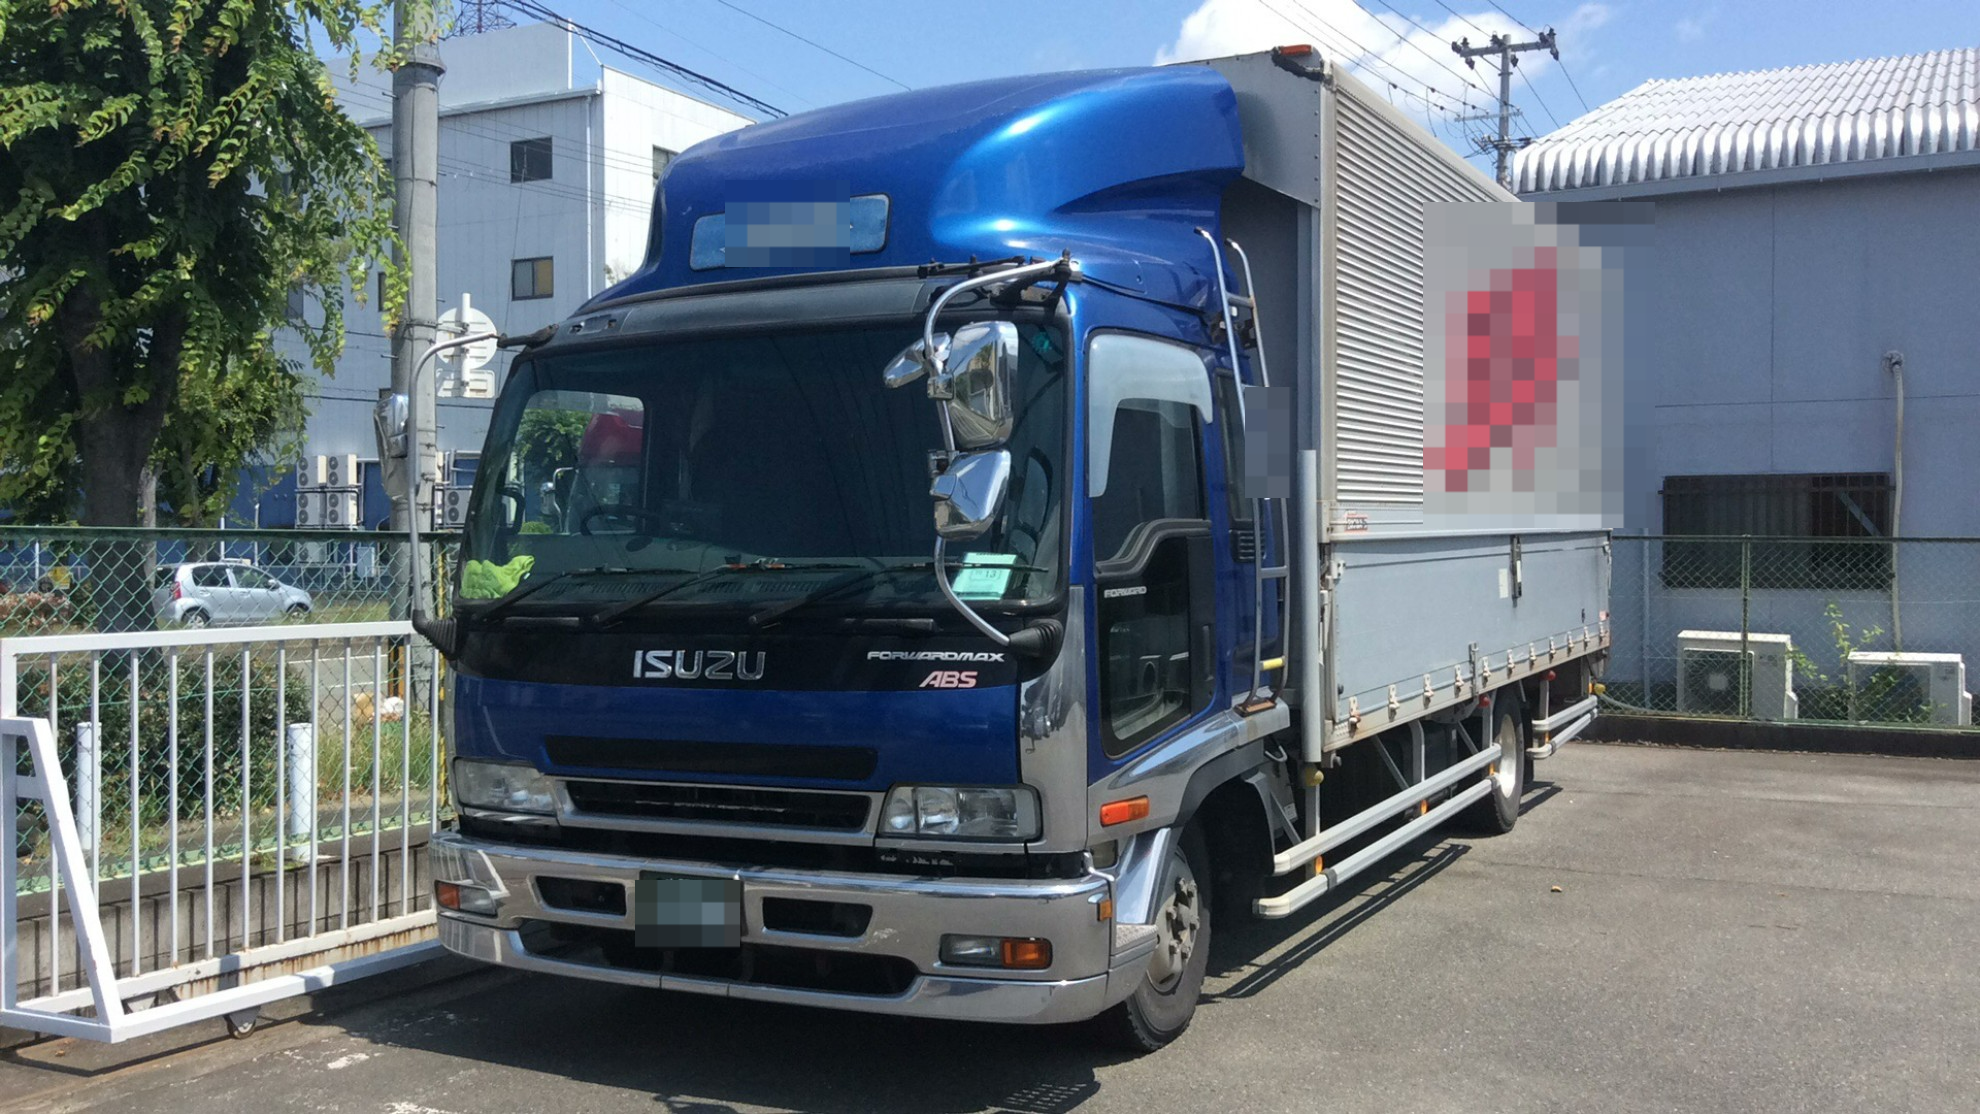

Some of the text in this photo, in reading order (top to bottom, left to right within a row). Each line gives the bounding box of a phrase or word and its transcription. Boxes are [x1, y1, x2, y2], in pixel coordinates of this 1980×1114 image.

[1104, 586, 1147, 598] FORWARD
[867, 651, 1005, 662] FORWARDMAX
[633, 650, 766, 680] ISUZU
[919, 671, 978, 688] ABS
